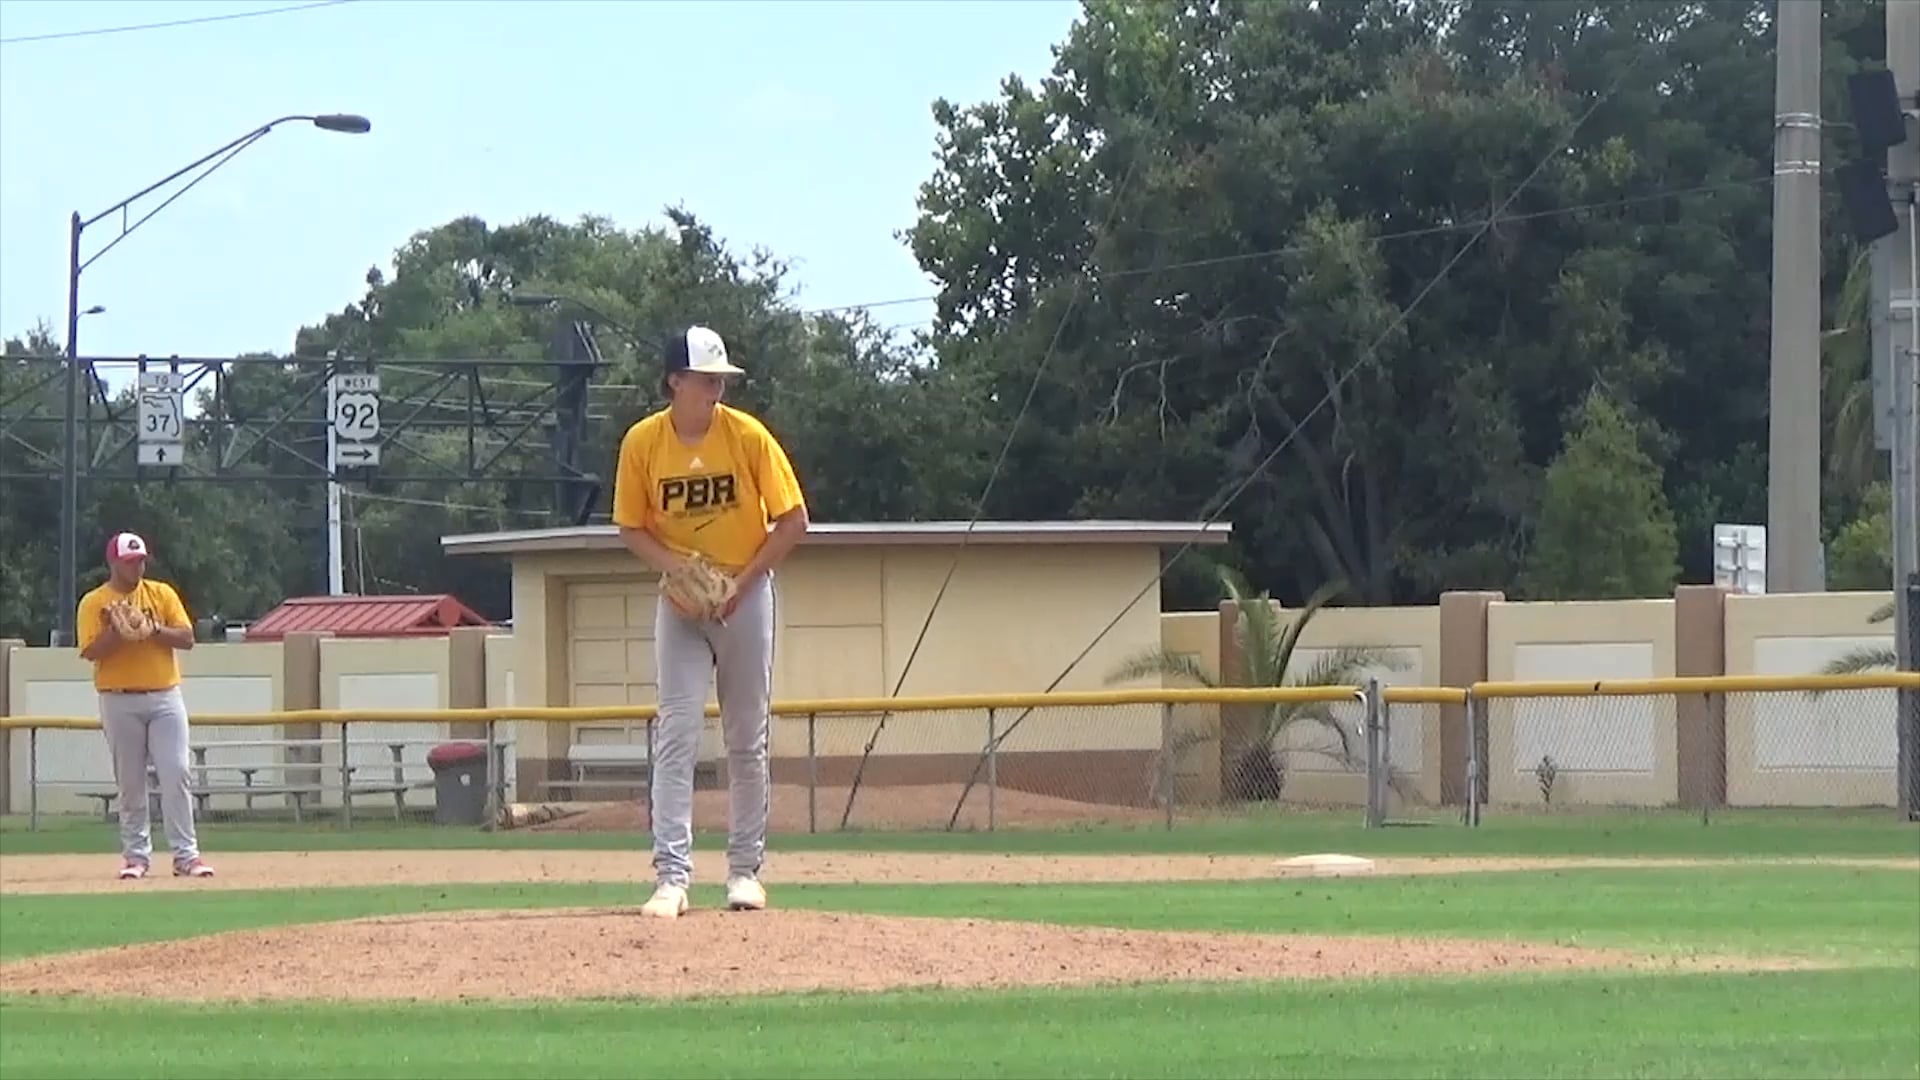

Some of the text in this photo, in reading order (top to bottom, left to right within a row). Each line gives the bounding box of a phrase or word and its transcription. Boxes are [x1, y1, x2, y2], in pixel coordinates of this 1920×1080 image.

[155, 375, 169, 385] TO
[343, 377, 372, 388] WEST
[146, 414, 170, 432] 37
[342, 403, 374, 429] 92
[661, 474, 736, 511] PBR
